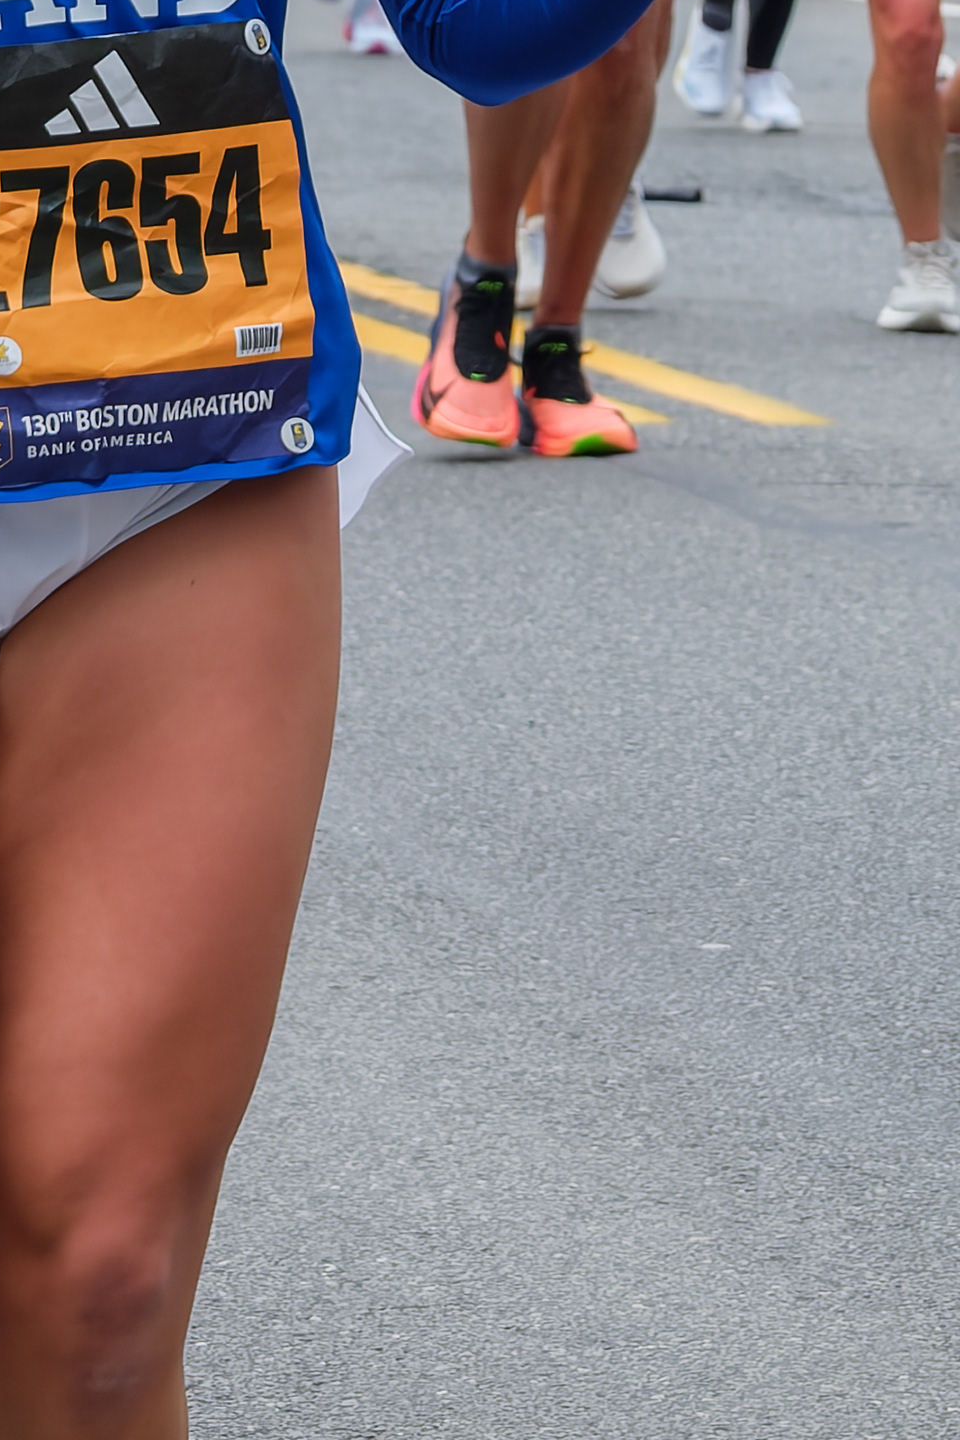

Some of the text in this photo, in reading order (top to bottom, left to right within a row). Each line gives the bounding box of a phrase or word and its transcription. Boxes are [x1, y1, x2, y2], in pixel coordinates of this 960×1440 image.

[22, 389, 274, 437] 130TH BOSTON MARATHON
[27, 430, 173, 458] BANK OF AMERICA
